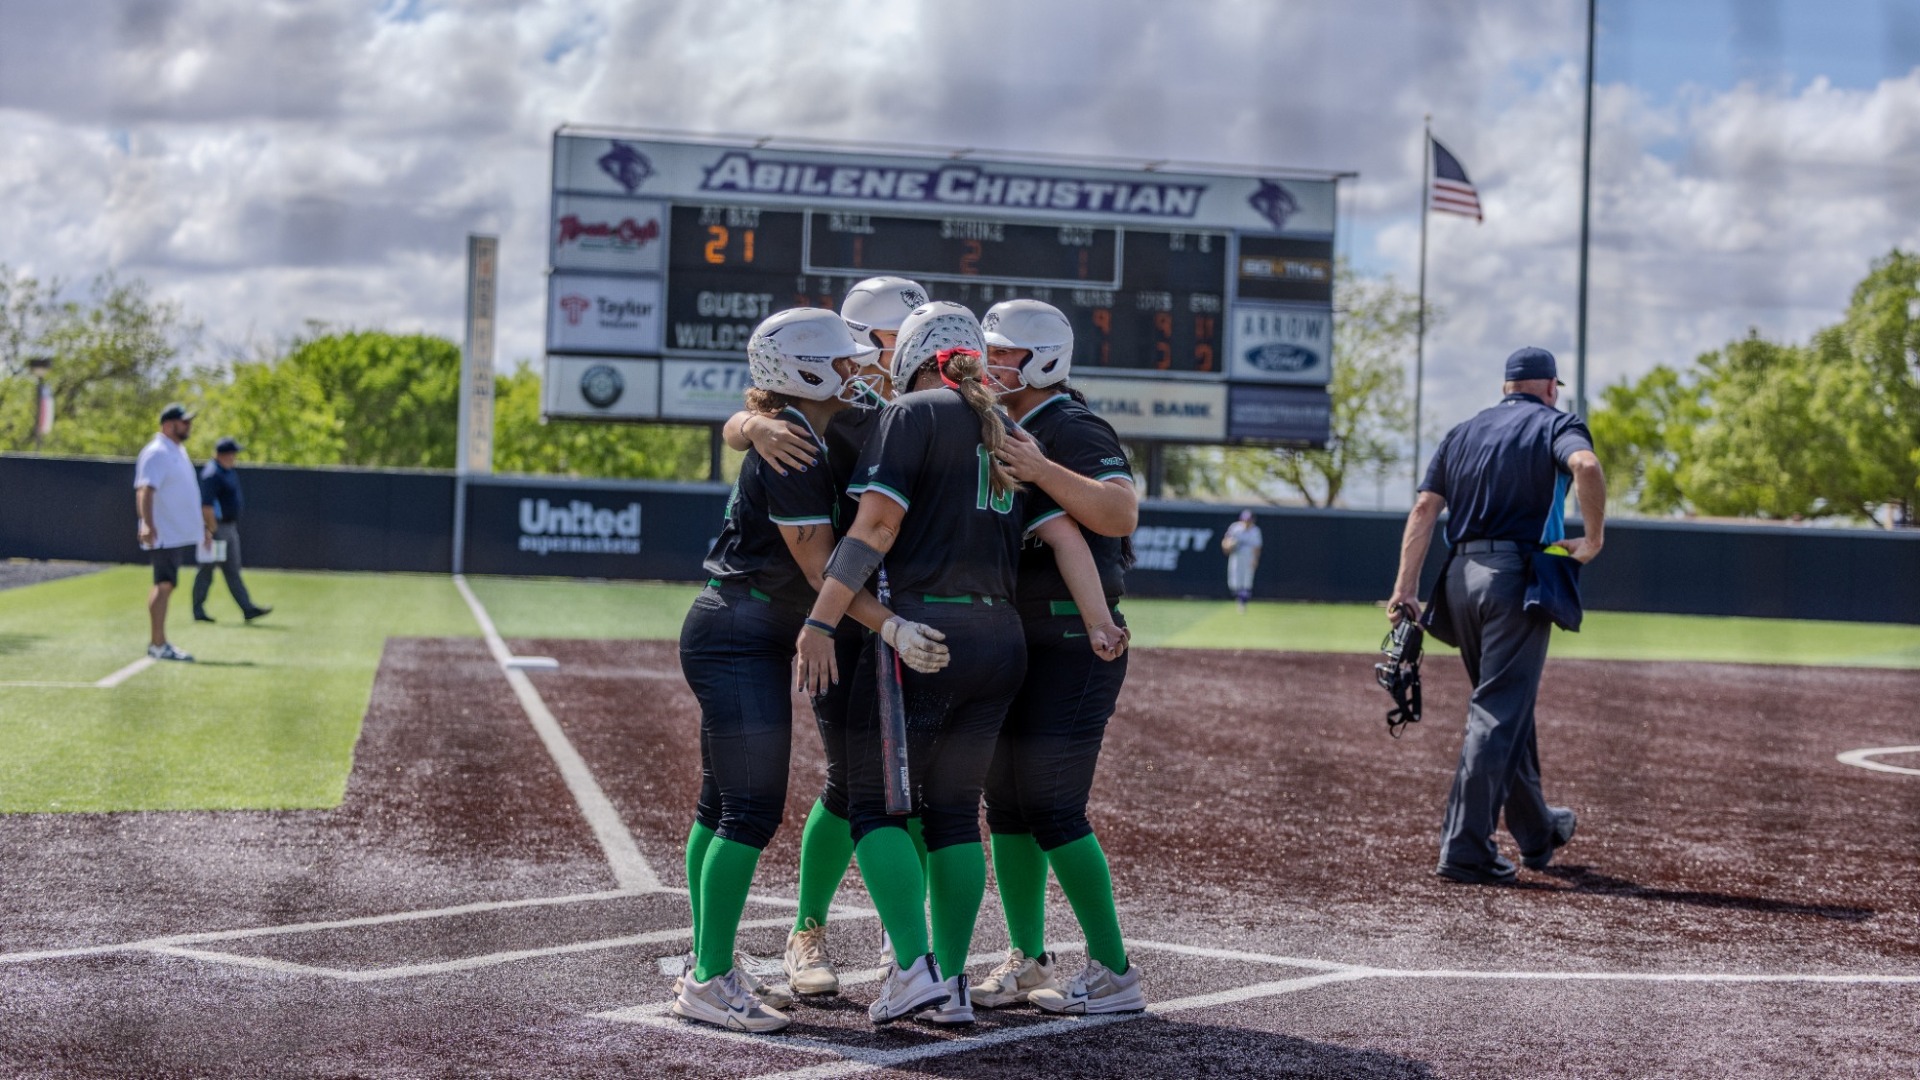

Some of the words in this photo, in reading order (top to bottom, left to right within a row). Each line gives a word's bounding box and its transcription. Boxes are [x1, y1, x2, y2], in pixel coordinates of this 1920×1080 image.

[708, 155, 928, 199] ABILENE
[935, 169, 1199, 215] CHRISTIAN
[704, 224, 755, 265] 21
[696, 290, 775, 319] GUEST
[674, 321, 750, 351] WILDC
[1153, 401, 1212, 418] BANK
[519, 497, 642, 537] United
[1131, 526, 1214, 552] OCITY
